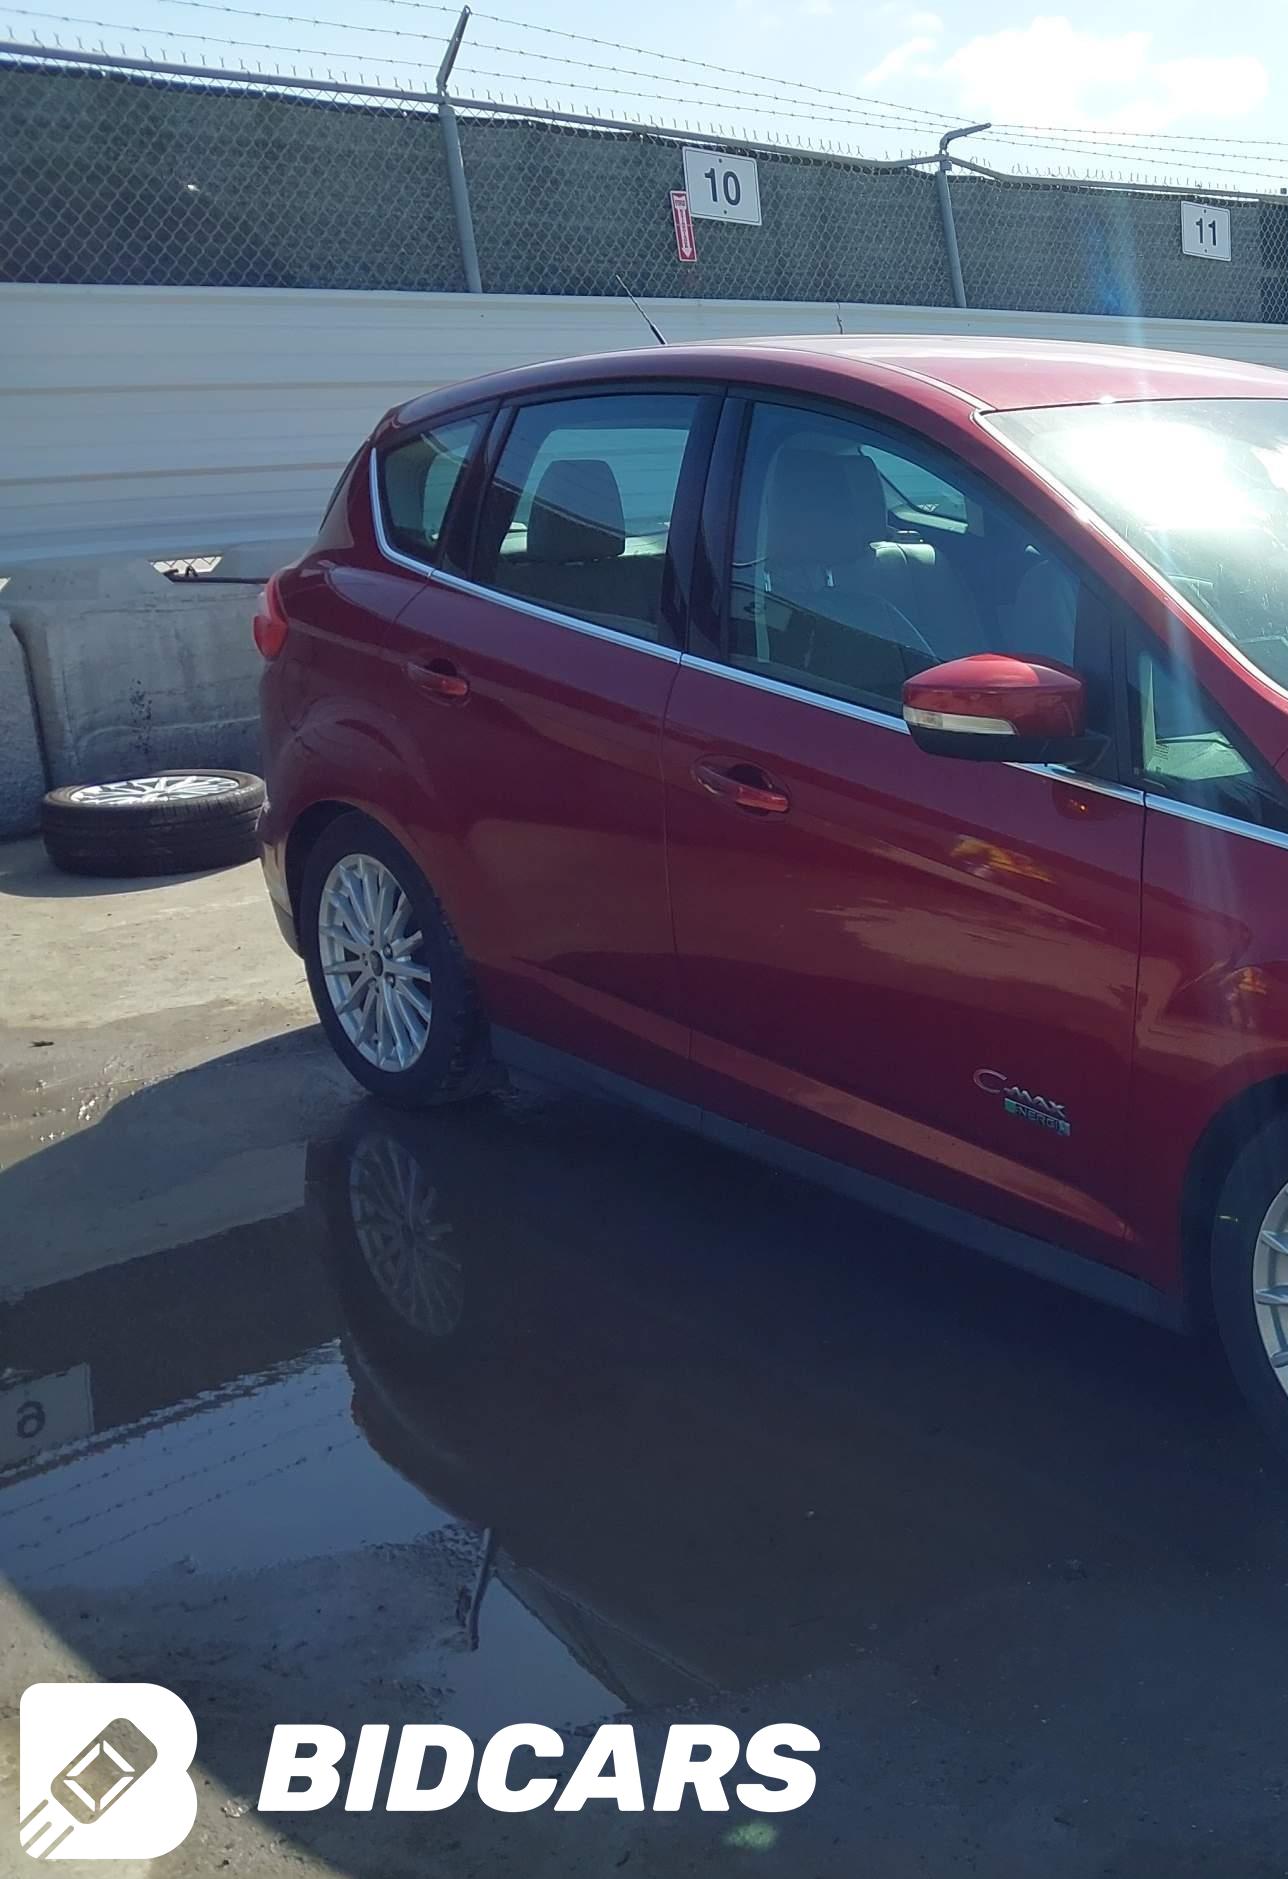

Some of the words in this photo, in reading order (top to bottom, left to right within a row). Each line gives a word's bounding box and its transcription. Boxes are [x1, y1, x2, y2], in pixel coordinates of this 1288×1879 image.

[704, 167, 741, 206] 10
[1195, 217, 1217, 246] 11
[973, 1068, 1065, 1119] C-MAX
